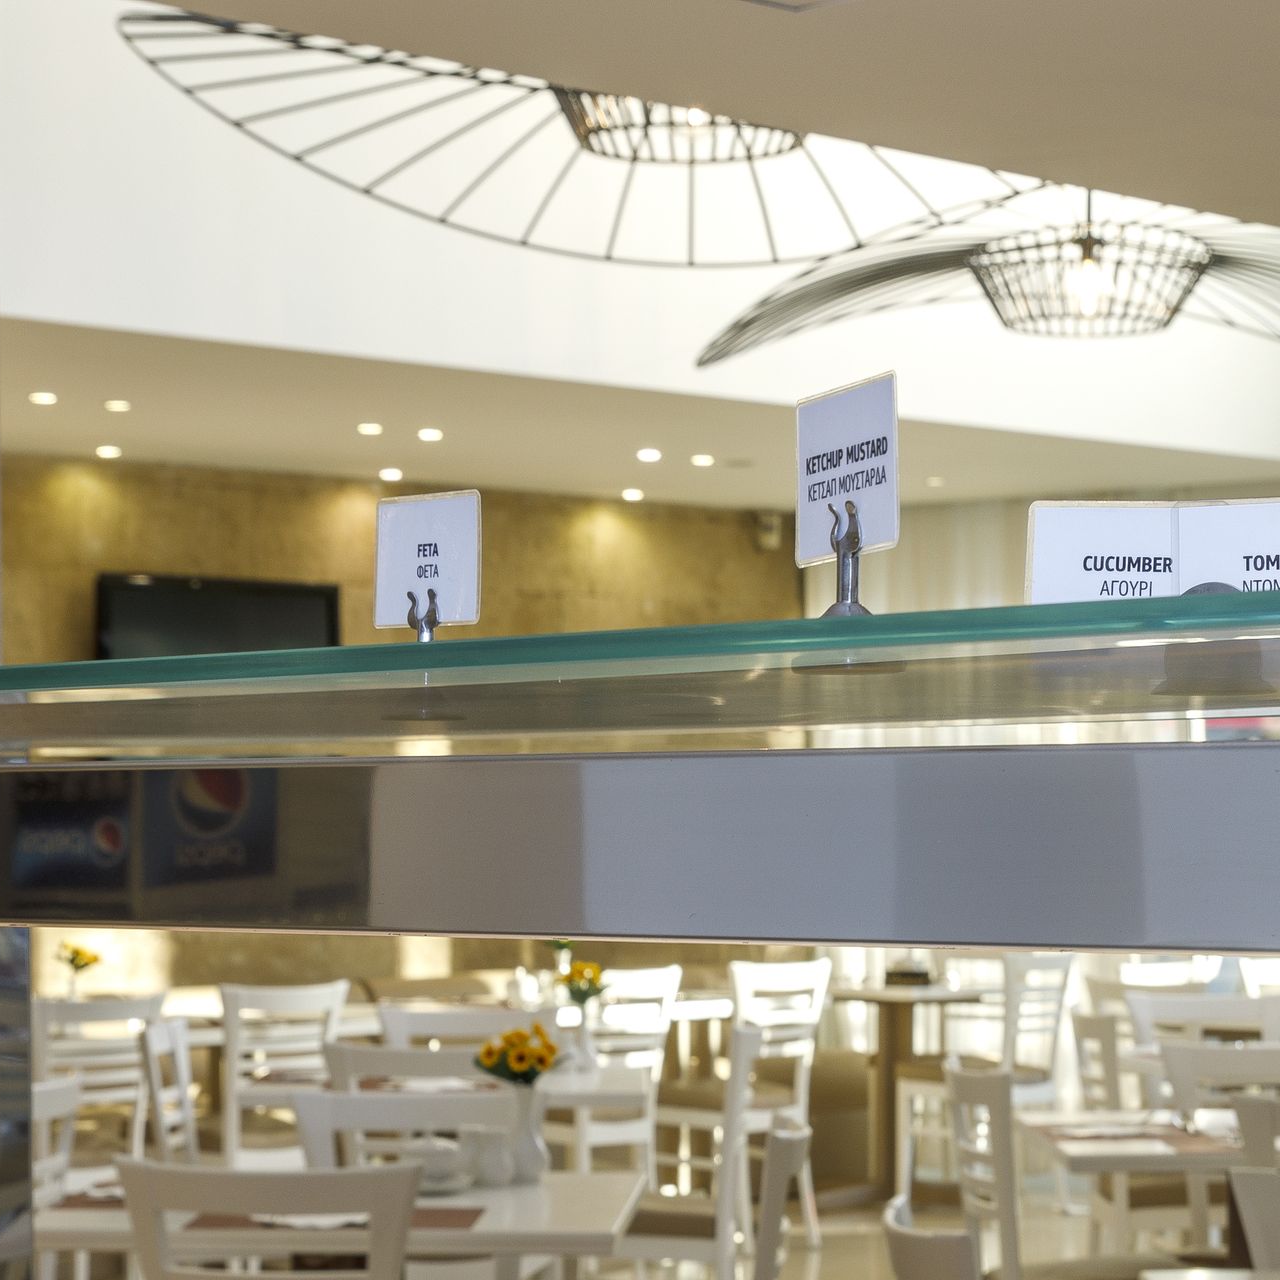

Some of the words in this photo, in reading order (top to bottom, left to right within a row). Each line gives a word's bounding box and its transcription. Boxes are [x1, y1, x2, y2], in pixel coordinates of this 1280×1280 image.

[806, 449, 843, 476] KETCHUP
[846, 436, 888, 463] MUSTARD
[807, 477, 837, 502] ΚΕΤΣΑΠ
[838, 465, 887, 496] ΜΟΥΣΤΑΡΔΑ
[417, 543, 439, 557] FETA
[416, 564, 439, 579] ΦΕΤΑ
[1083, 555, 1173, 573] CUCUMBER
[1100, 580, 1153, 597] ΑΓΟΥΡΙ
